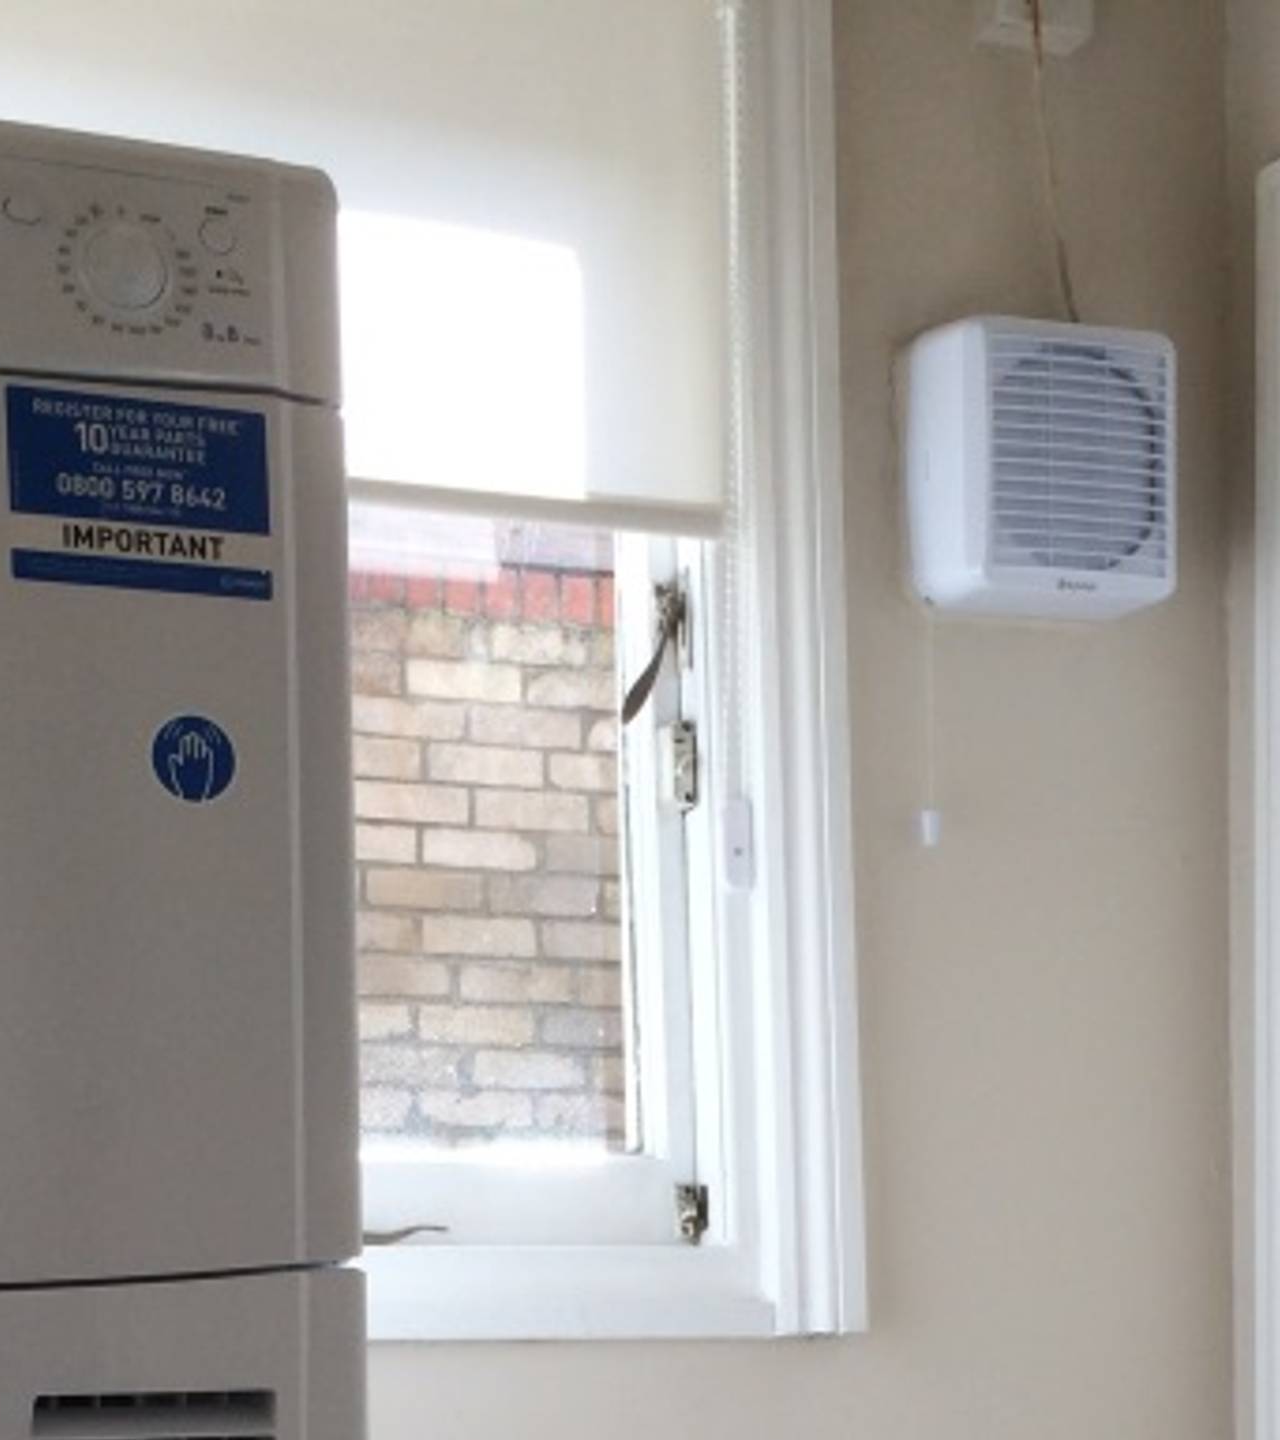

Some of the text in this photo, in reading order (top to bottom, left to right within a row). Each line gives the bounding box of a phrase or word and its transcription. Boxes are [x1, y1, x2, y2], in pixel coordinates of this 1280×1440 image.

[32, 396, 241, 437] REGISTER FOR YOUR FREE
[74, 421, 110, 456] 10
[55, 471, 115, 499] 0800
[120, 479, 166, 505] 597
[169, 484, 228, 513] 8642
[62, 523, 226, 561] IMPORTANT
